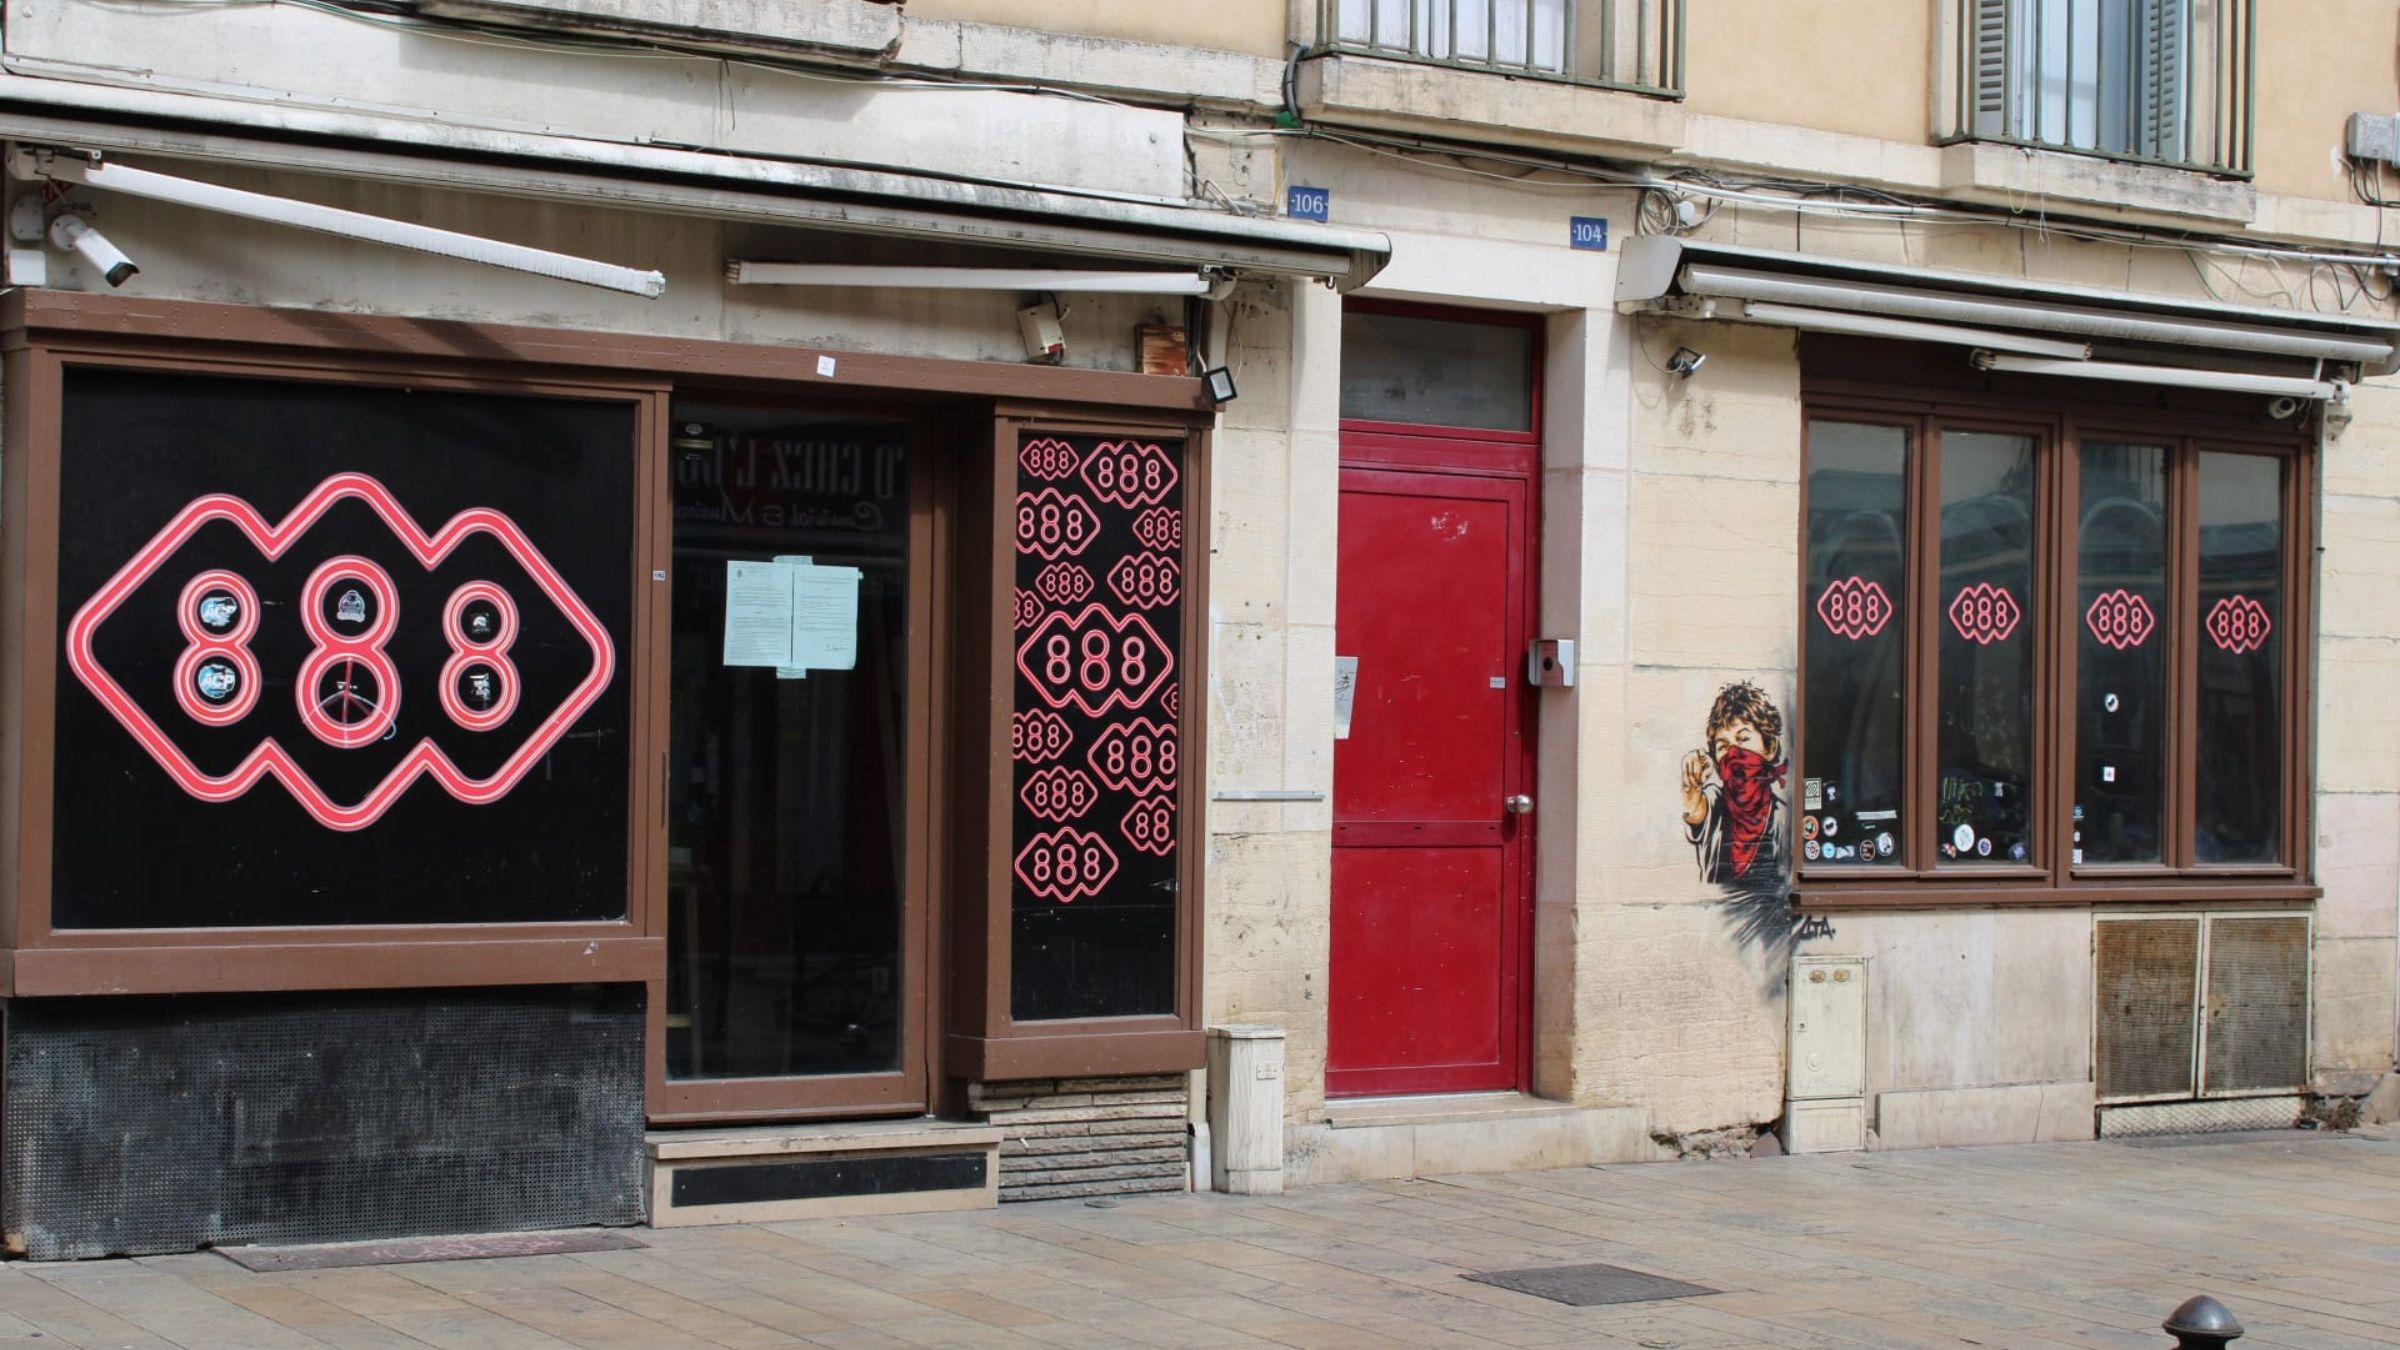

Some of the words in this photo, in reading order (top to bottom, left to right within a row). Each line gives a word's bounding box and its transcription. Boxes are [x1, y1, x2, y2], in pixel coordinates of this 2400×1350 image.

[1294, 194, 1324, 214] 106
[1576, 224, 1603, 243] 104
[1030, 447, 1069, 472] 888
[1098, 454, 1160, 493] 888
[1018, 504, 1083, 544] 888
[1046, 571, 1084, 595] 888
[1121, 564, 1172, 596] 888
[1830, 590, 1879, 626] 888
[1962, 596, 2007, 631] 888
[2098, 602, 2142, 636] 888
[2218, 608, 2260, 642] 888
[173, 554, 520, 749] 888
[1046, 629, 1146, 692] 888
[1013, 721, 1059, 751] 888
[1107, 735, 1176, 779] 888
[1035, 778, 1084, 809] 888
[1033, 844, 1100, 885] 888
